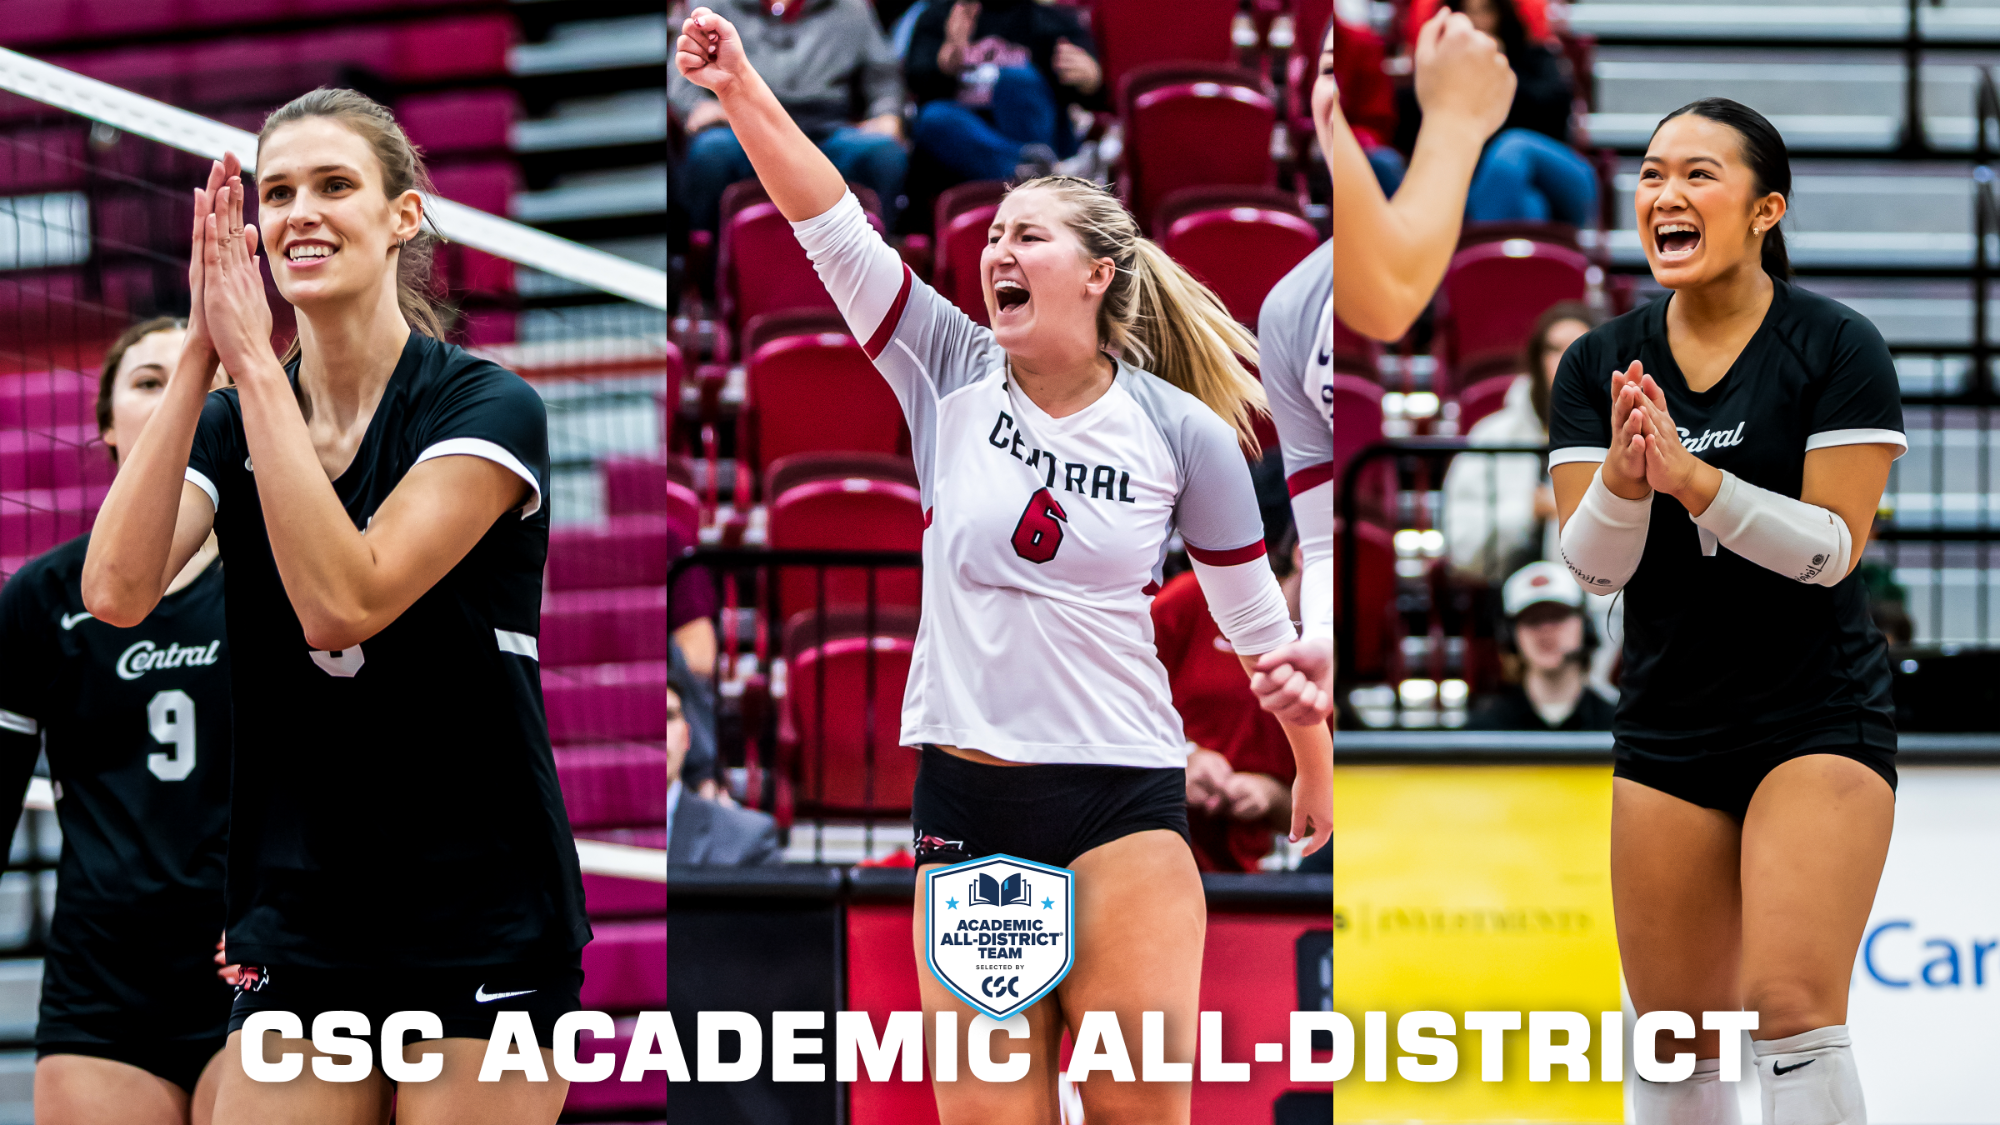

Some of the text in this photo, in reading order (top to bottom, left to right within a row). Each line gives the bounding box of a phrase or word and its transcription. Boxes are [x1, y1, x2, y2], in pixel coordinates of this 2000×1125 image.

[988, 410, 1136, 504] CENTRAL
[1010, 486, 1068, 565] 6
[115, 639, 221, 681] Central
[146, 688, 197, 782] 9
